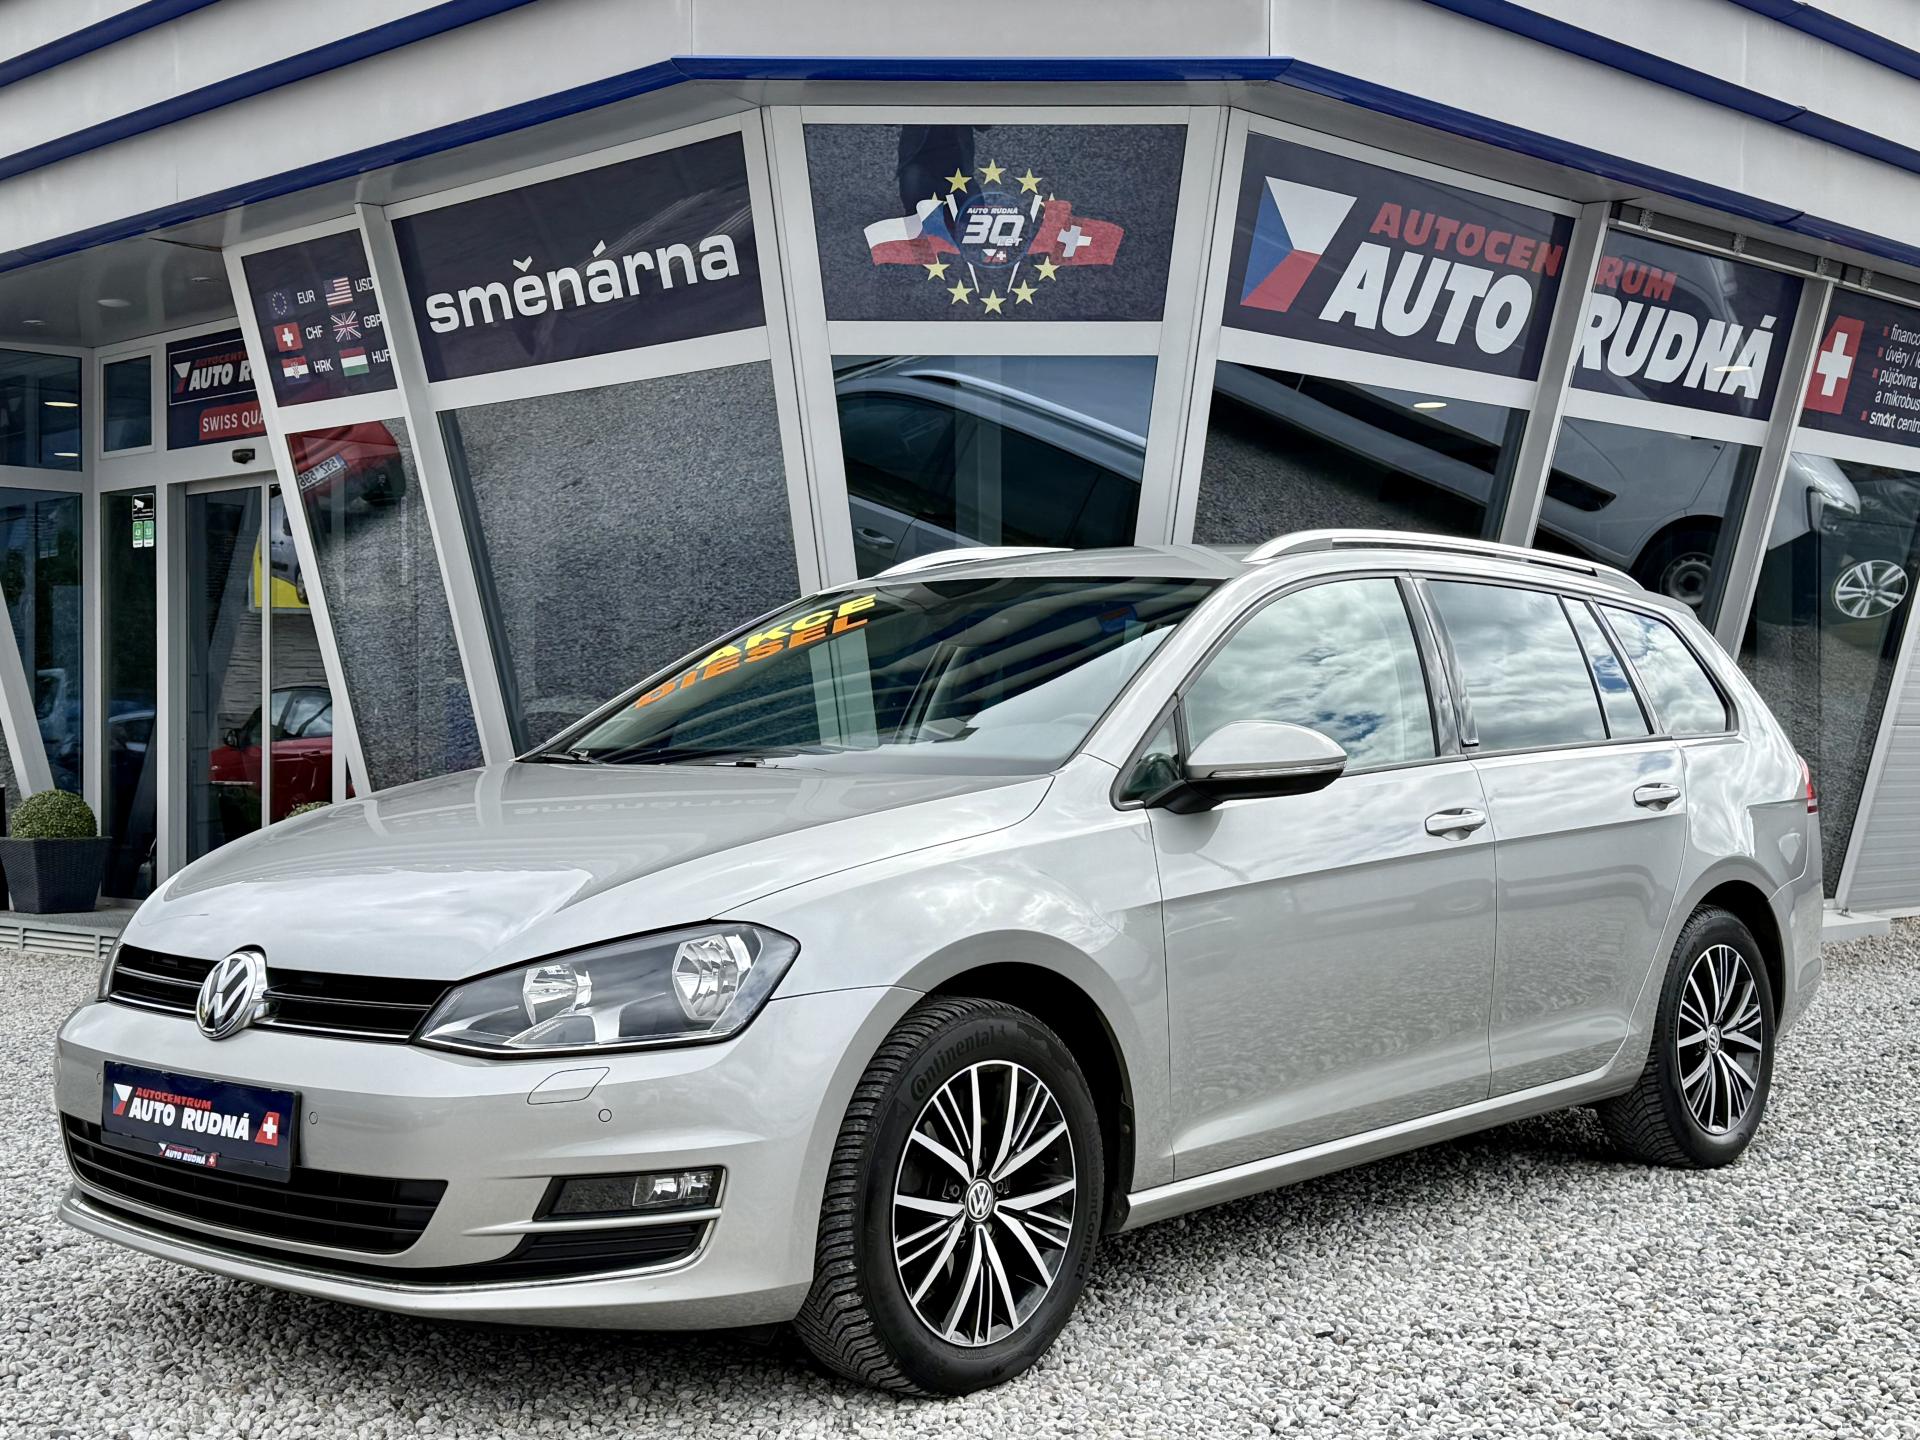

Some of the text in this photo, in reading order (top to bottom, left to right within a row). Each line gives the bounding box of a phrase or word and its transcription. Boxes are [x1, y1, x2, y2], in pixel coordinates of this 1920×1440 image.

[961, 214, 1025, 244] 30
[1369, 201, 1563, 277] AUTOCEN
[296, 277, 375, 305] EUR USD
[425, 233, 741, 335] směnárna
[305, 313, 382, 340] CHF GBP
[1318, 240, 1778, 400] AUTO RUDNÁ
[313, 348, 391, 374] HRK HUF
[188, 363, 234, 392] AUTO
[1874, 390, 1883, 403] a
[202, 412, 238, 433] SWISS
[697, 593, 877, 670] AKCE
[634, 614, 869, 710] DIESEL
[910, 1025, 994, 1102] Continental
[135, 1086, 213, 1110] AUTOCENTRUM
[128, 1097, 250, 1141] AUTO RUDNÁ
[164, 1148, 182, 1160] AUTO
